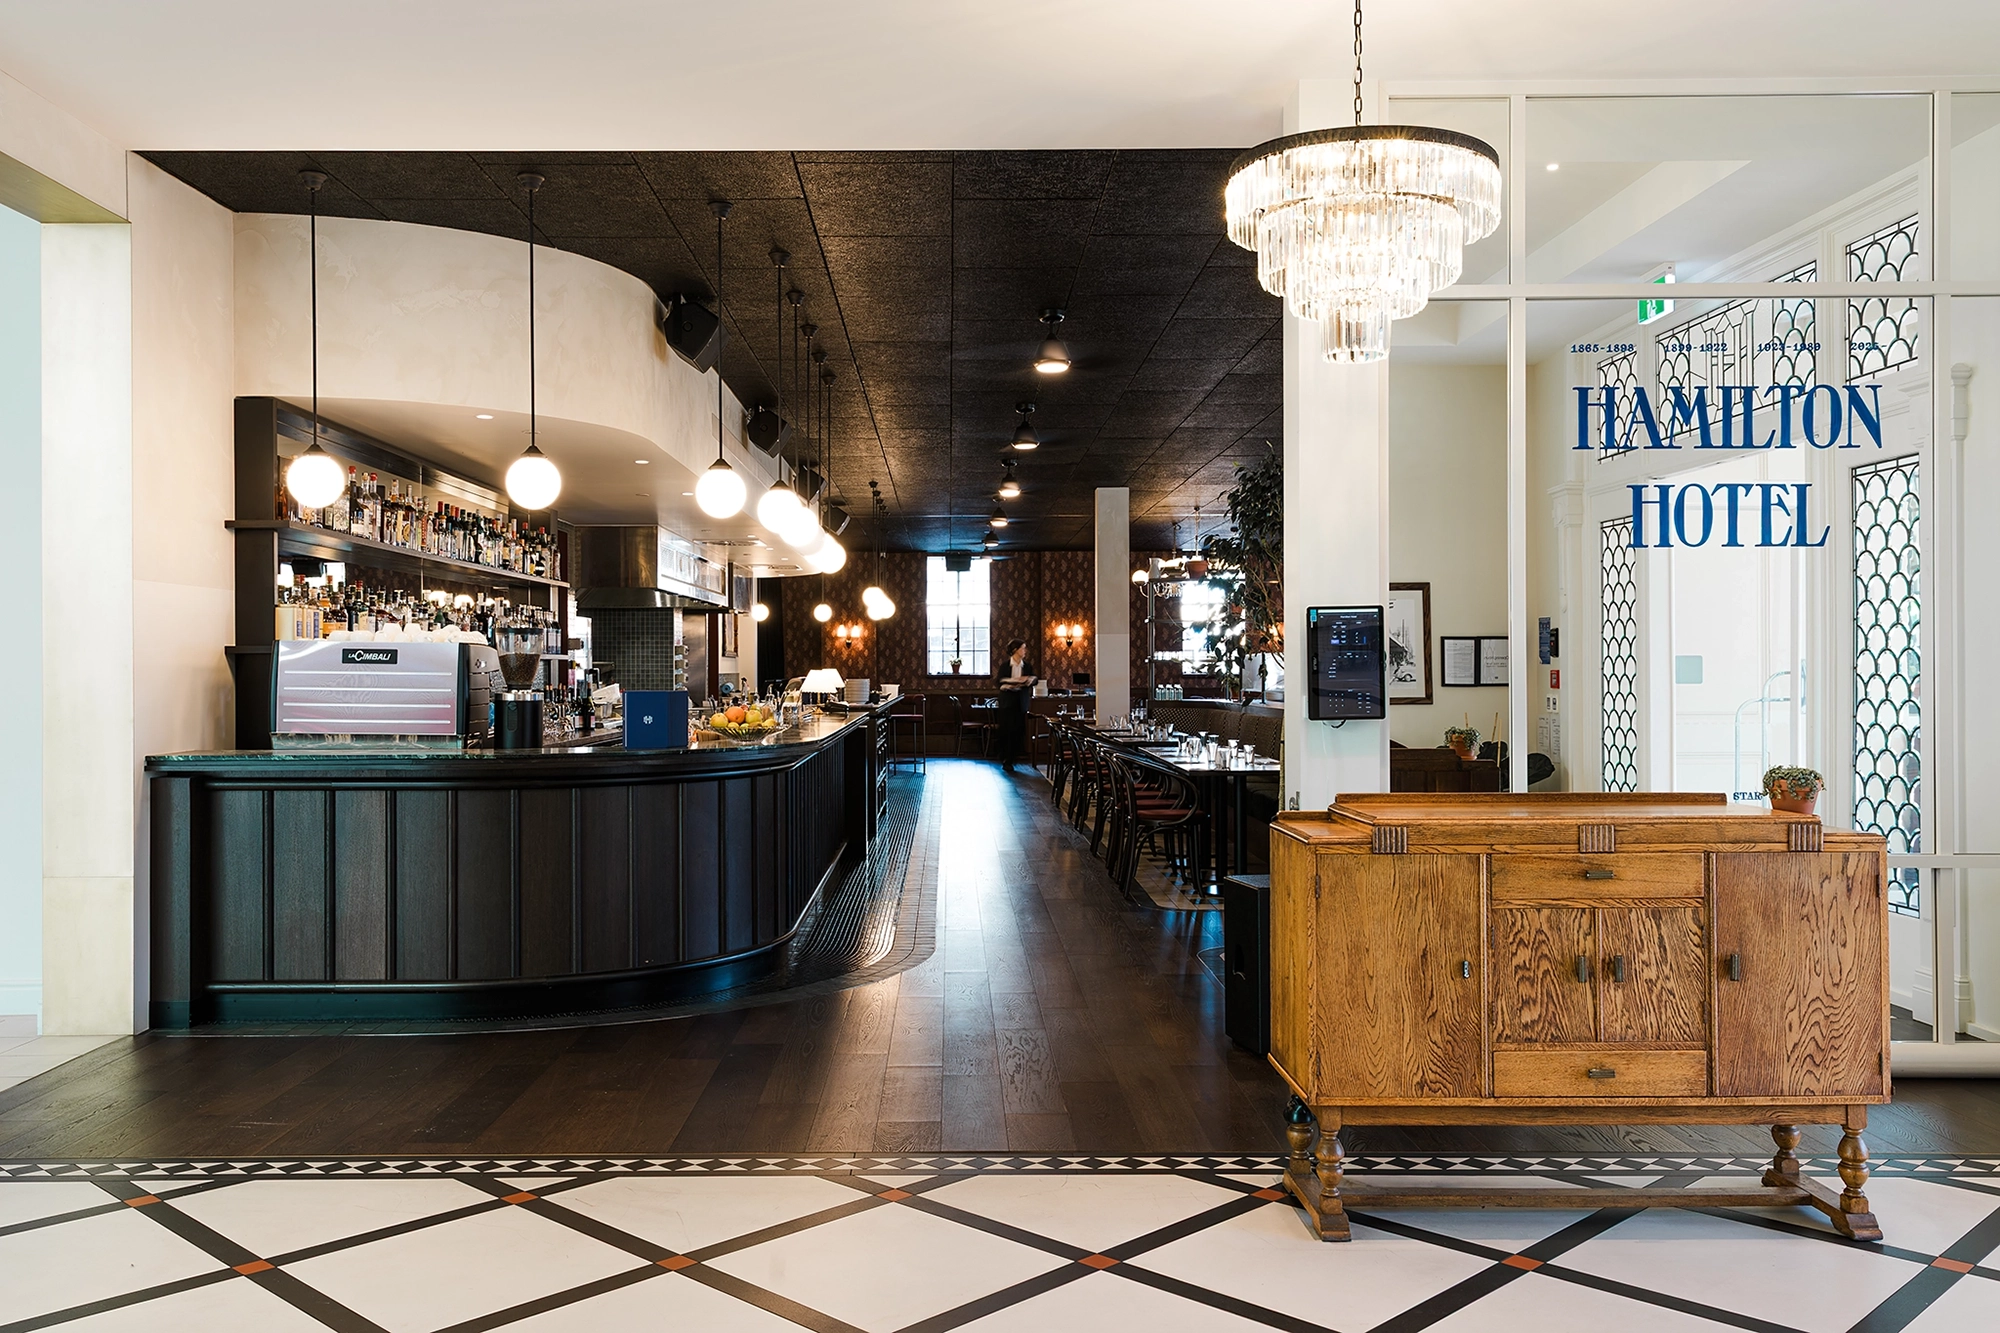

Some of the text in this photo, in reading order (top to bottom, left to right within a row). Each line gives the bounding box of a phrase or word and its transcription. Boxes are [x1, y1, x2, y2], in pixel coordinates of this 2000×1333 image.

[1571, 343, 1635, 353] 1865-1898
[1572, 384, 1883, 449] HAMILTON
[1627, 483, 1831, 548] HOTEL
